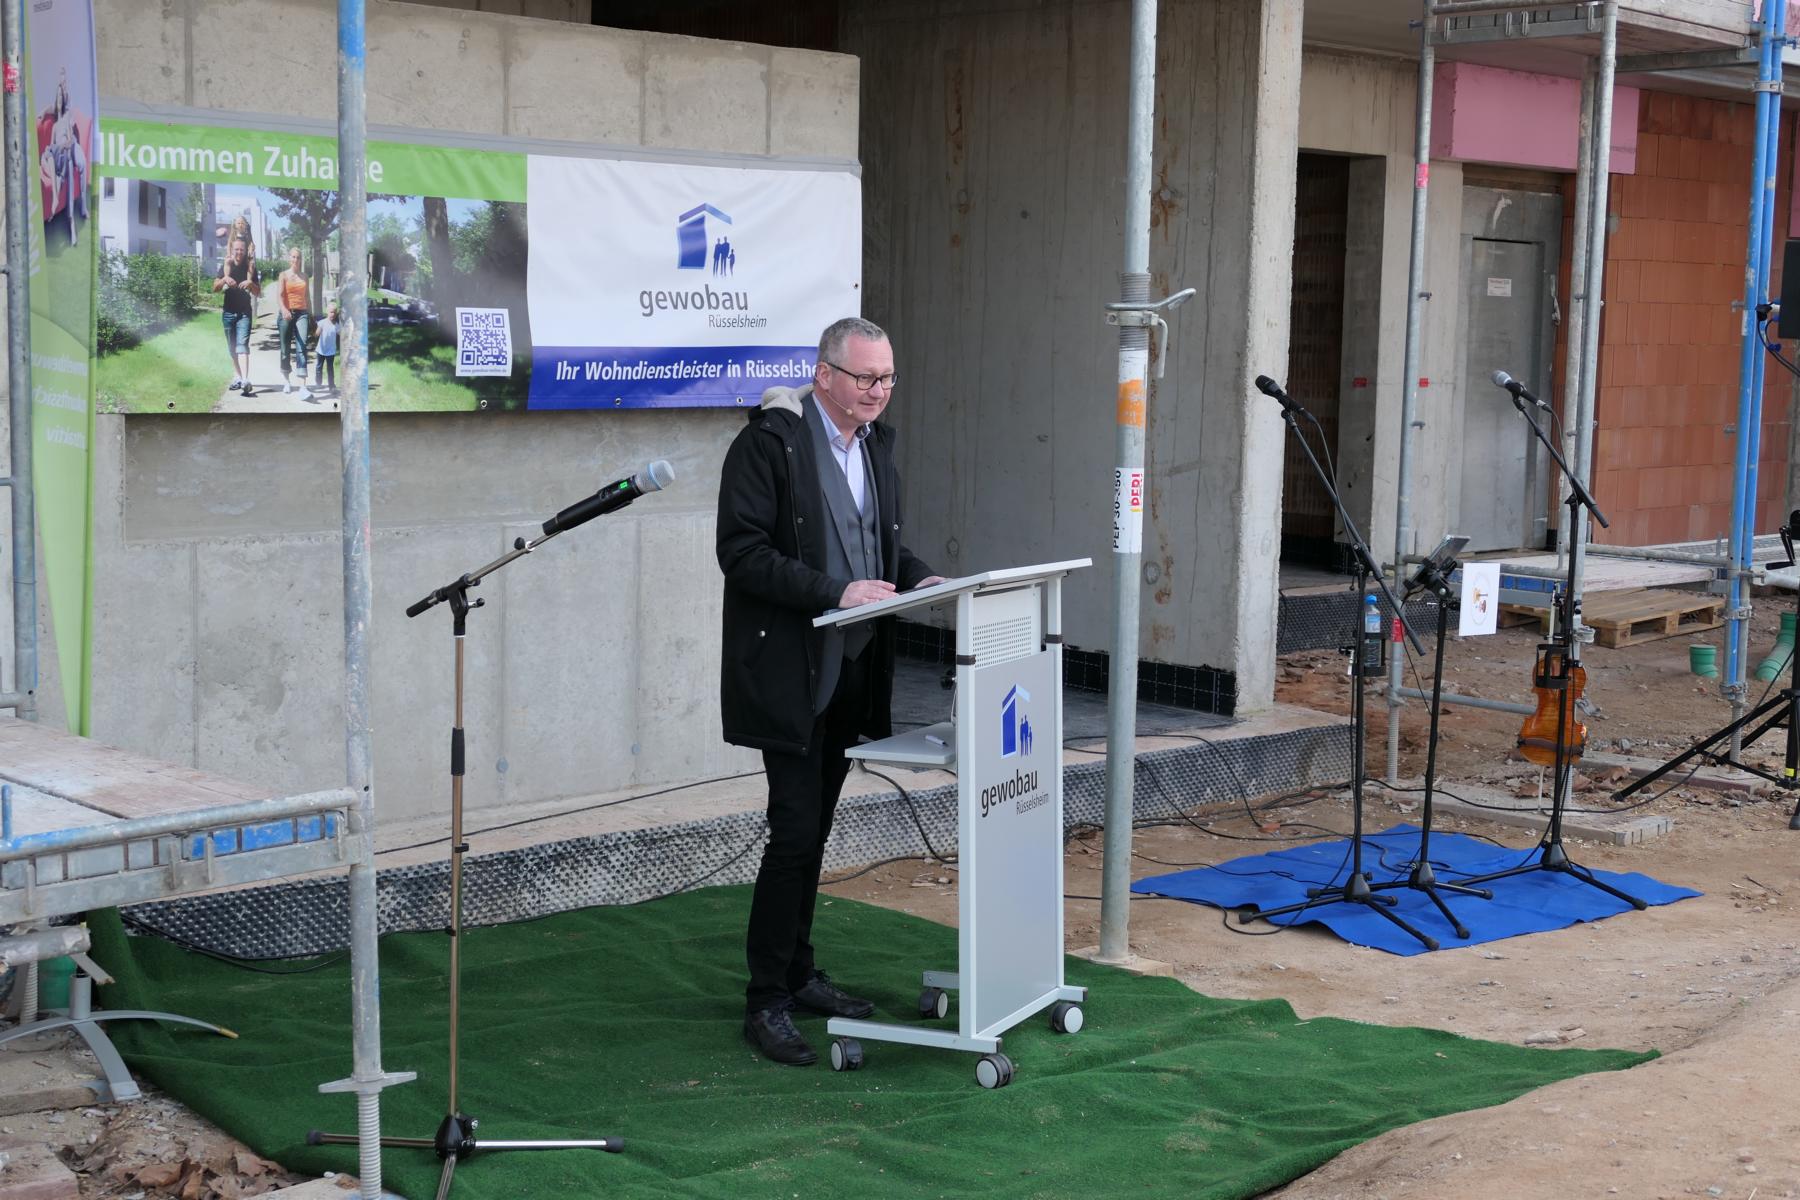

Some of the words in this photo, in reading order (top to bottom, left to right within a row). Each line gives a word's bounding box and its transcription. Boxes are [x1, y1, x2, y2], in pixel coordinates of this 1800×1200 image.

[98, 132, 254, 175] llkommen
[263, 146, 383, 183] Zuhae
[639, 283, 749, 317] gewobau
[707, 314, 767, 329] Rüsselsheim
[556, 360, 580, 380] Ihr
[585, 359, 723, 380] Wohndienstleister
[727, 359, 741, 378] in
[981, 768, 1038, 818] gewobau
[1016, 791, 1049, 816] Rüsselsheim
